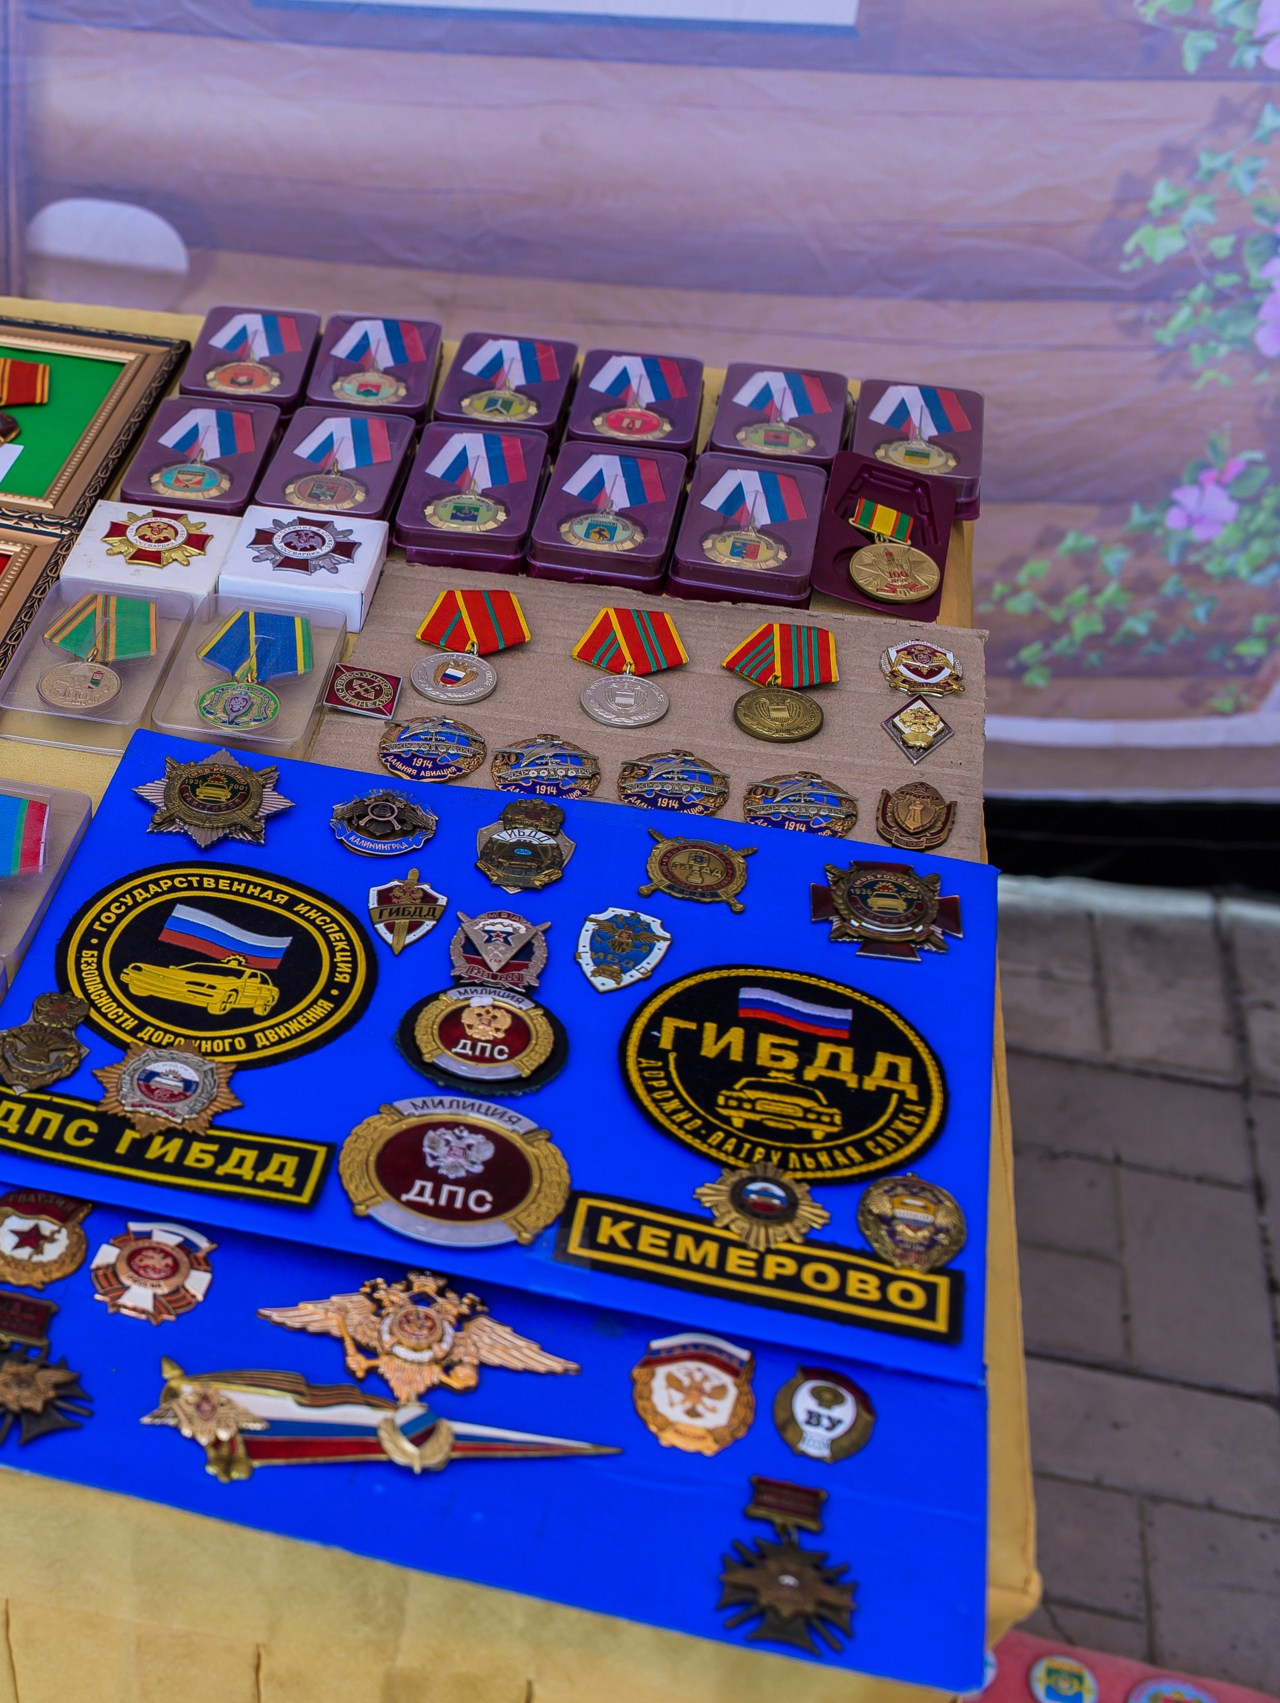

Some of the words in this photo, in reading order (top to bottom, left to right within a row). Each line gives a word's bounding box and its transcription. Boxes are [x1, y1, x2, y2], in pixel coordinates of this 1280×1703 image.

[412, 757, 433, 769] 1914
[419, 766, 458, 777] АВИАЦИЯ
[535, 785, 557, 795] 1914
[657, 797, 679, 809] 1914
[496, 829, 551, 844] ГИБДД
[784, 821, 806, 832] 1914
[348, 835, 410, 851] КАЛИНИНГРАД
[378, 904, 440, 920] ГИБДД
[93, 876, 289, 933] ГОСУДАРСТВЕННАЯ
[293, 902, 353, 984] ИНСПЕКЦИЯ
[81, 949, 139, 1031] БЕЗОПАСНОСТИ
[254, 998, 335, 1049] ДВИЖЕНИЯ
[456, 987, 525, 1005] МИЛИЦИЯ
[451, 1038, 510, 1061] ДПС
[658, 1016, 920, 1101] ГИБДД
[410, 1097, 522, 1127] МИЛИЦИЯ
[868, 1101, 926, 1157] СЛУЖБА
[114, 1129, 301, 1190] ГИБДД
[401, 1179, 494, 1214] ДПС
[595, 1214, 929, 1311] КЕМЕРОВО
[805, 1410, 843, 1432] ВУ
